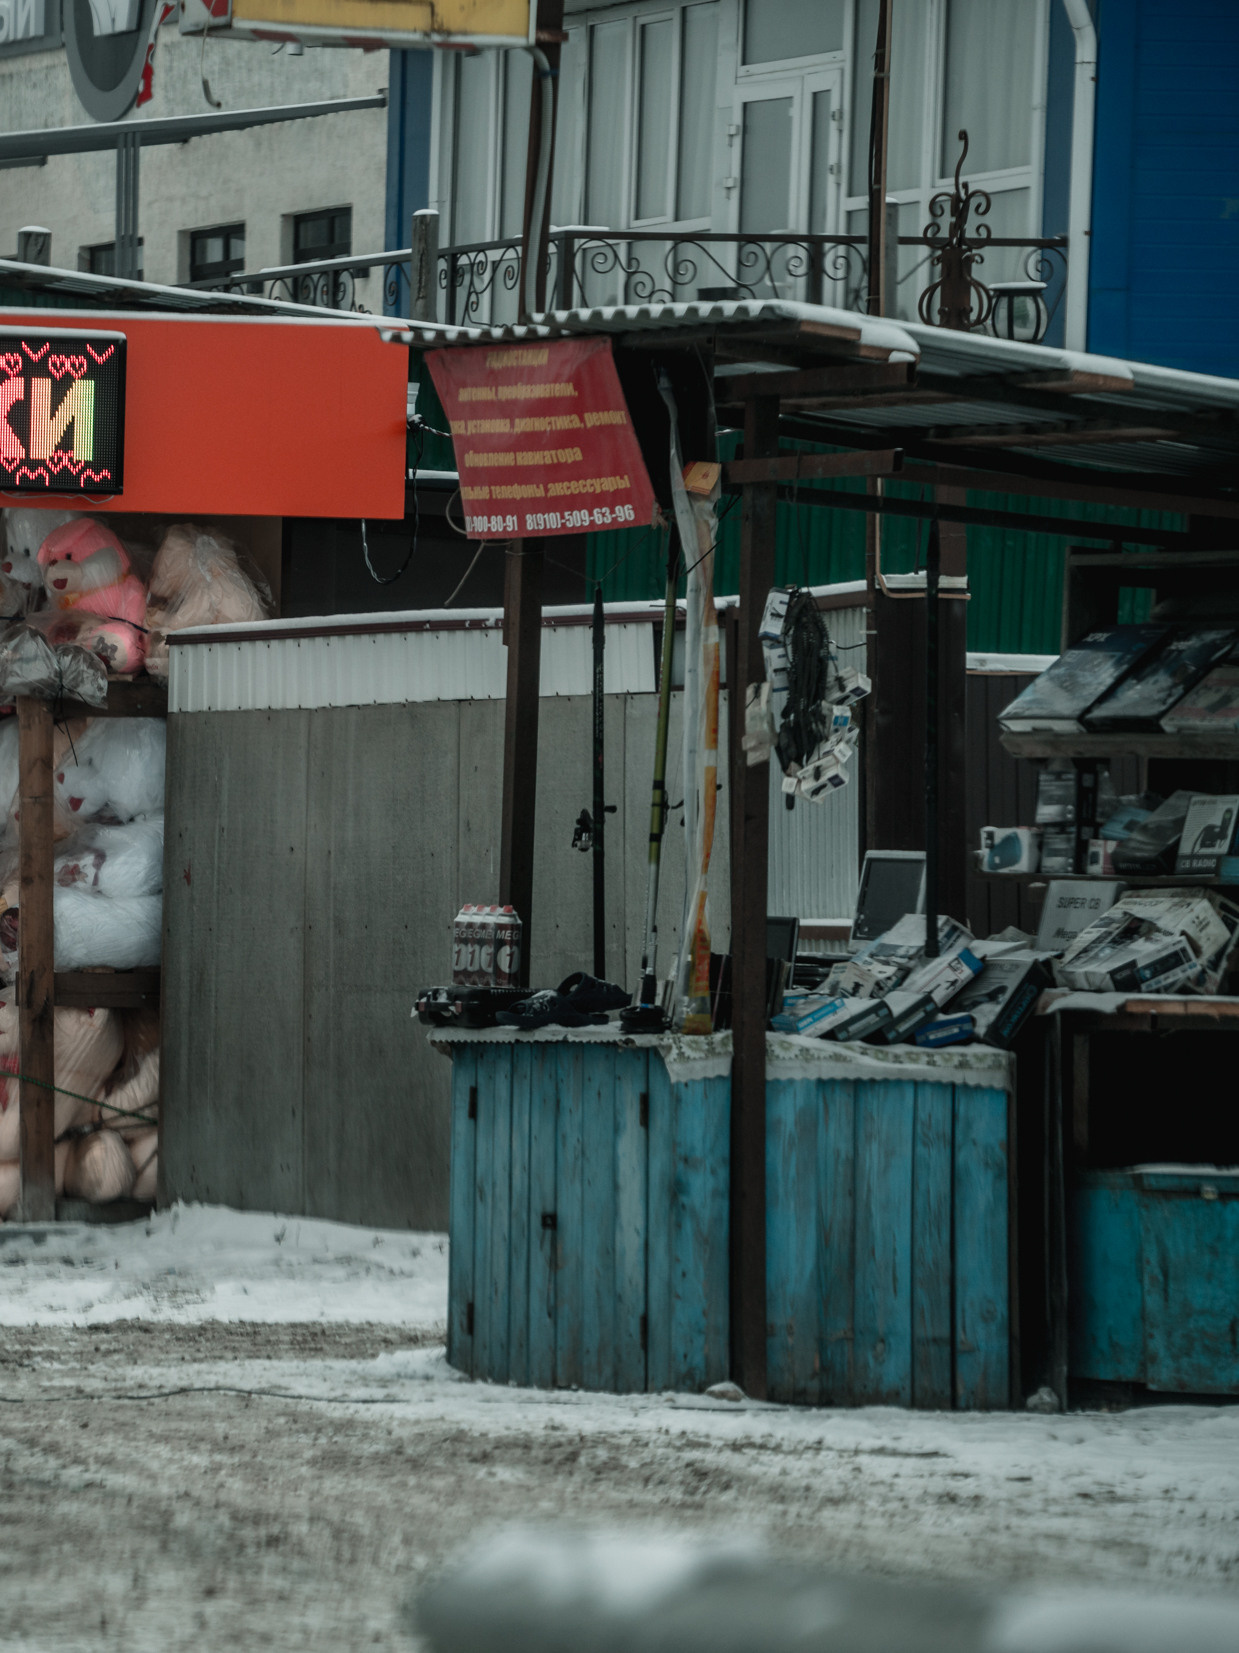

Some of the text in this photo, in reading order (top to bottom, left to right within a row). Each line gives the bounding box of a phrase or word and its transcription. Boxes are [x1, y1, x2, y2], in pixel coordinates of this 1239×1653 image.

[584, 410, 627, 430] ремонт
[464, 446, 583, 468] обновление навигатора
[491, 482, 545, 500] телефоны
